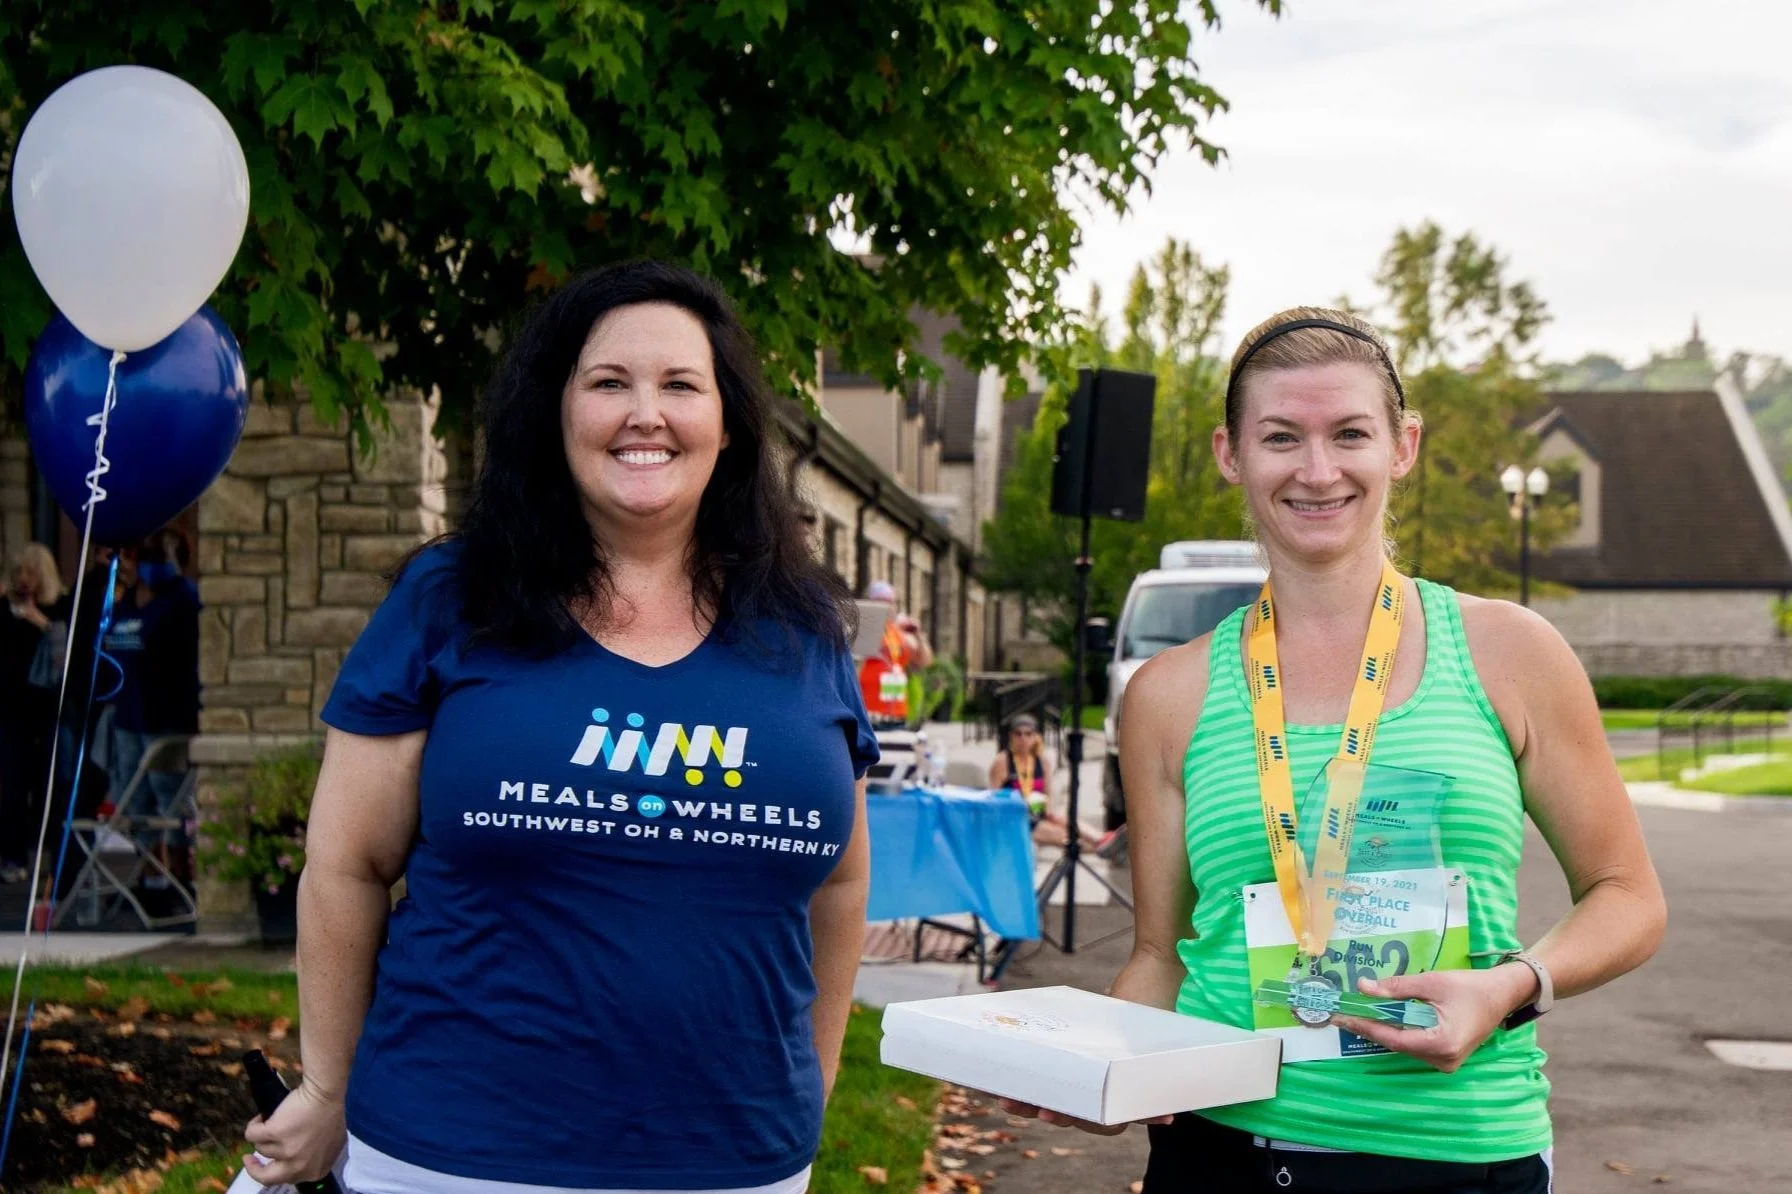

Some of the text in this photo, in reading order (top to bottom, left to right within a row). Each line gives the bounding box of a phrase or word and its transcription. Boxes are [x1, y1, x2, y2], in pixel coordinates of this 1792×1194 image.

[498, 780, 629, 812] MEALS
[671, 799, 822, 830] WHEELS
[463, 811, 841, 857] SOUTHWEST OH & NORTHERN KY
[1393, 879, 1418, 891] 2021
[1369, 895, 1410, 912] PLACE
[1333, 907, 1397, 928] OVERALL
[1349, 939, 1373, 953] RUN
[1333, 951, 1385, 969] DIVISION
